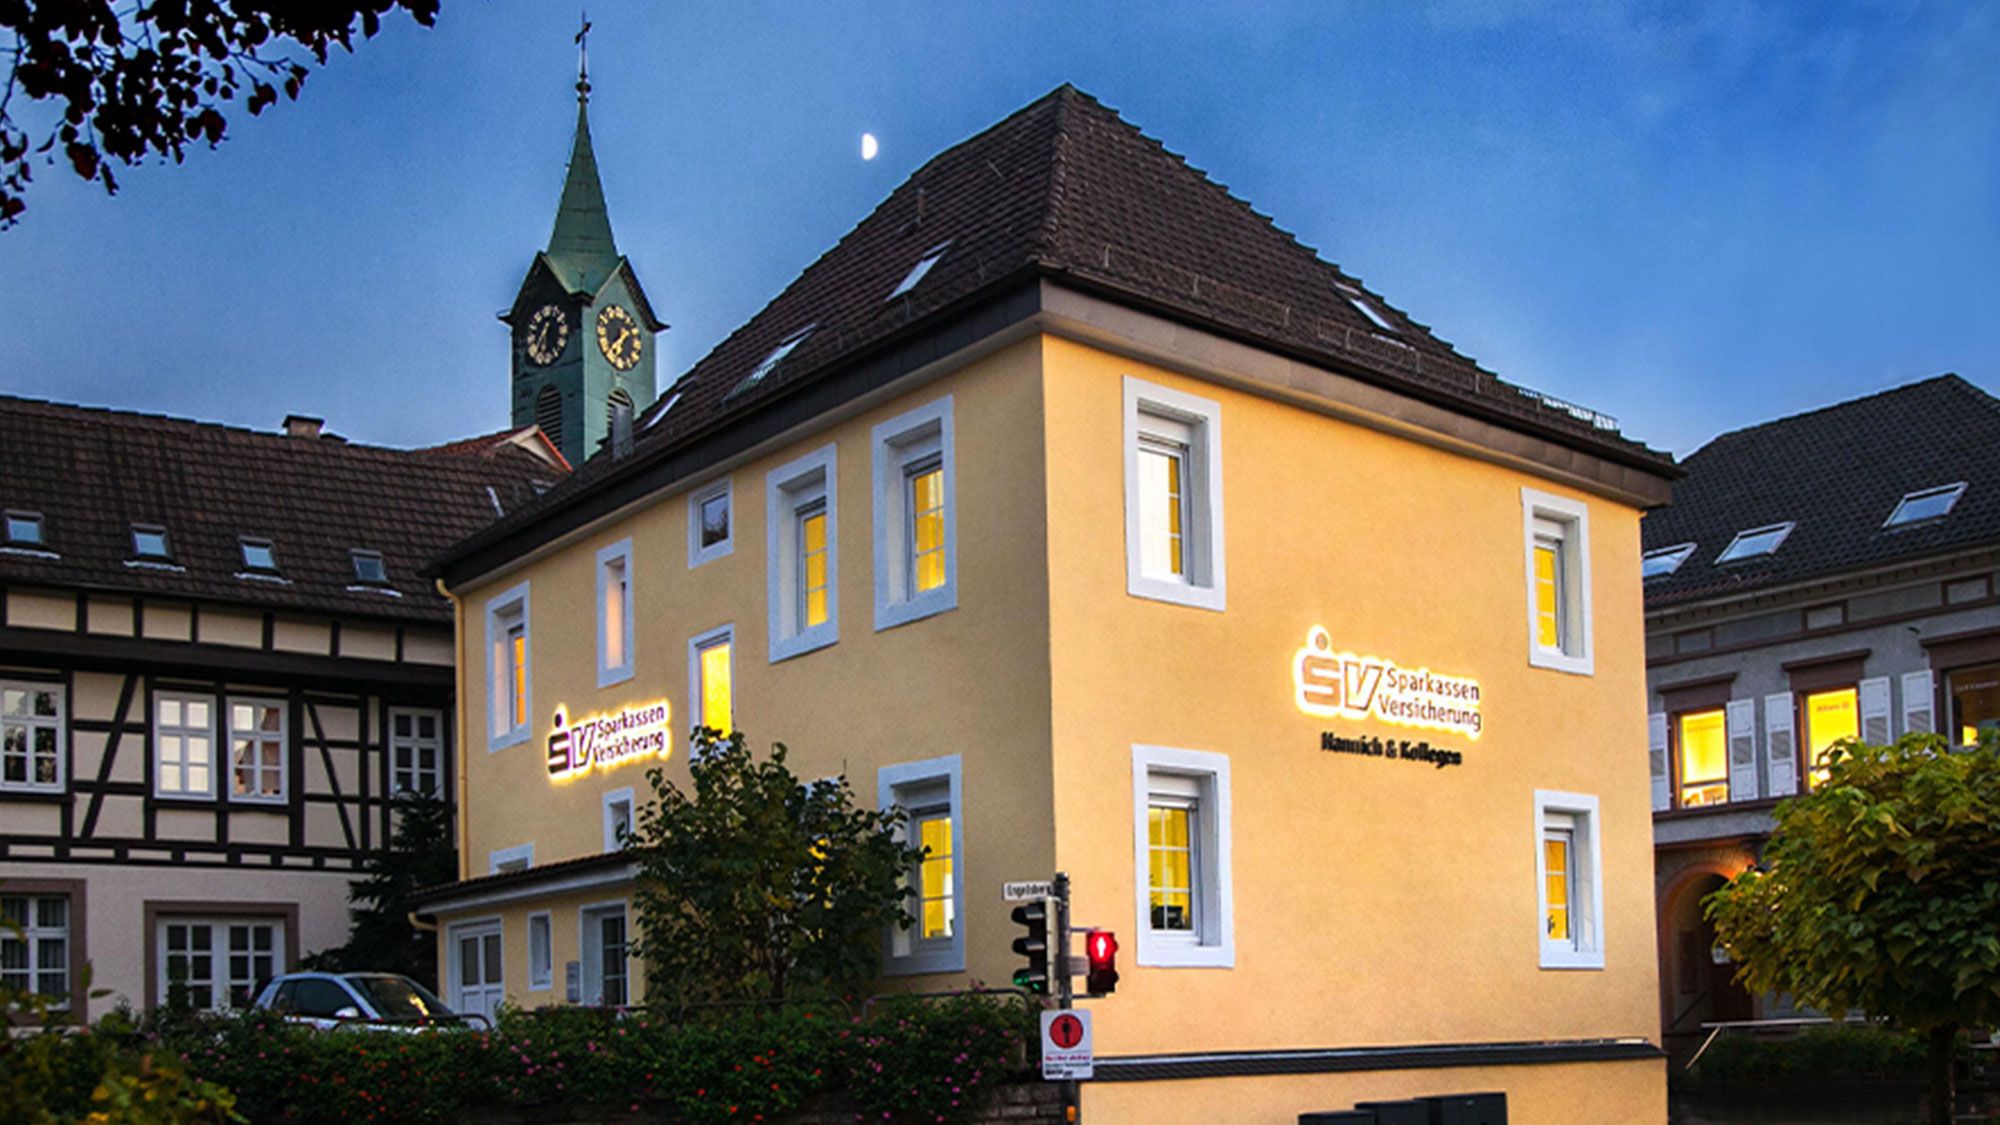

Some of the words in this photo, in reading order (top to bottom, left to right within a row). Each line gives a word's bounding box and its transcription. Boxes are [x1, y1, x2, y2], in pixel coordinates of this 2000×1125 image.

[1302, 632, 1383, 712] SV
[1386, 668, 1480, 700] Sparkassen
[597, 706, 665, 741] Sparkassen
[1378, 694, 1482, 732] Versicherung
[548, 713, 596, 774] SV
[593, 731, 665, 763] Versicherung
[1385, 739, 1398, 759] &
[1400, 741, 1462, 769] Kollegen
